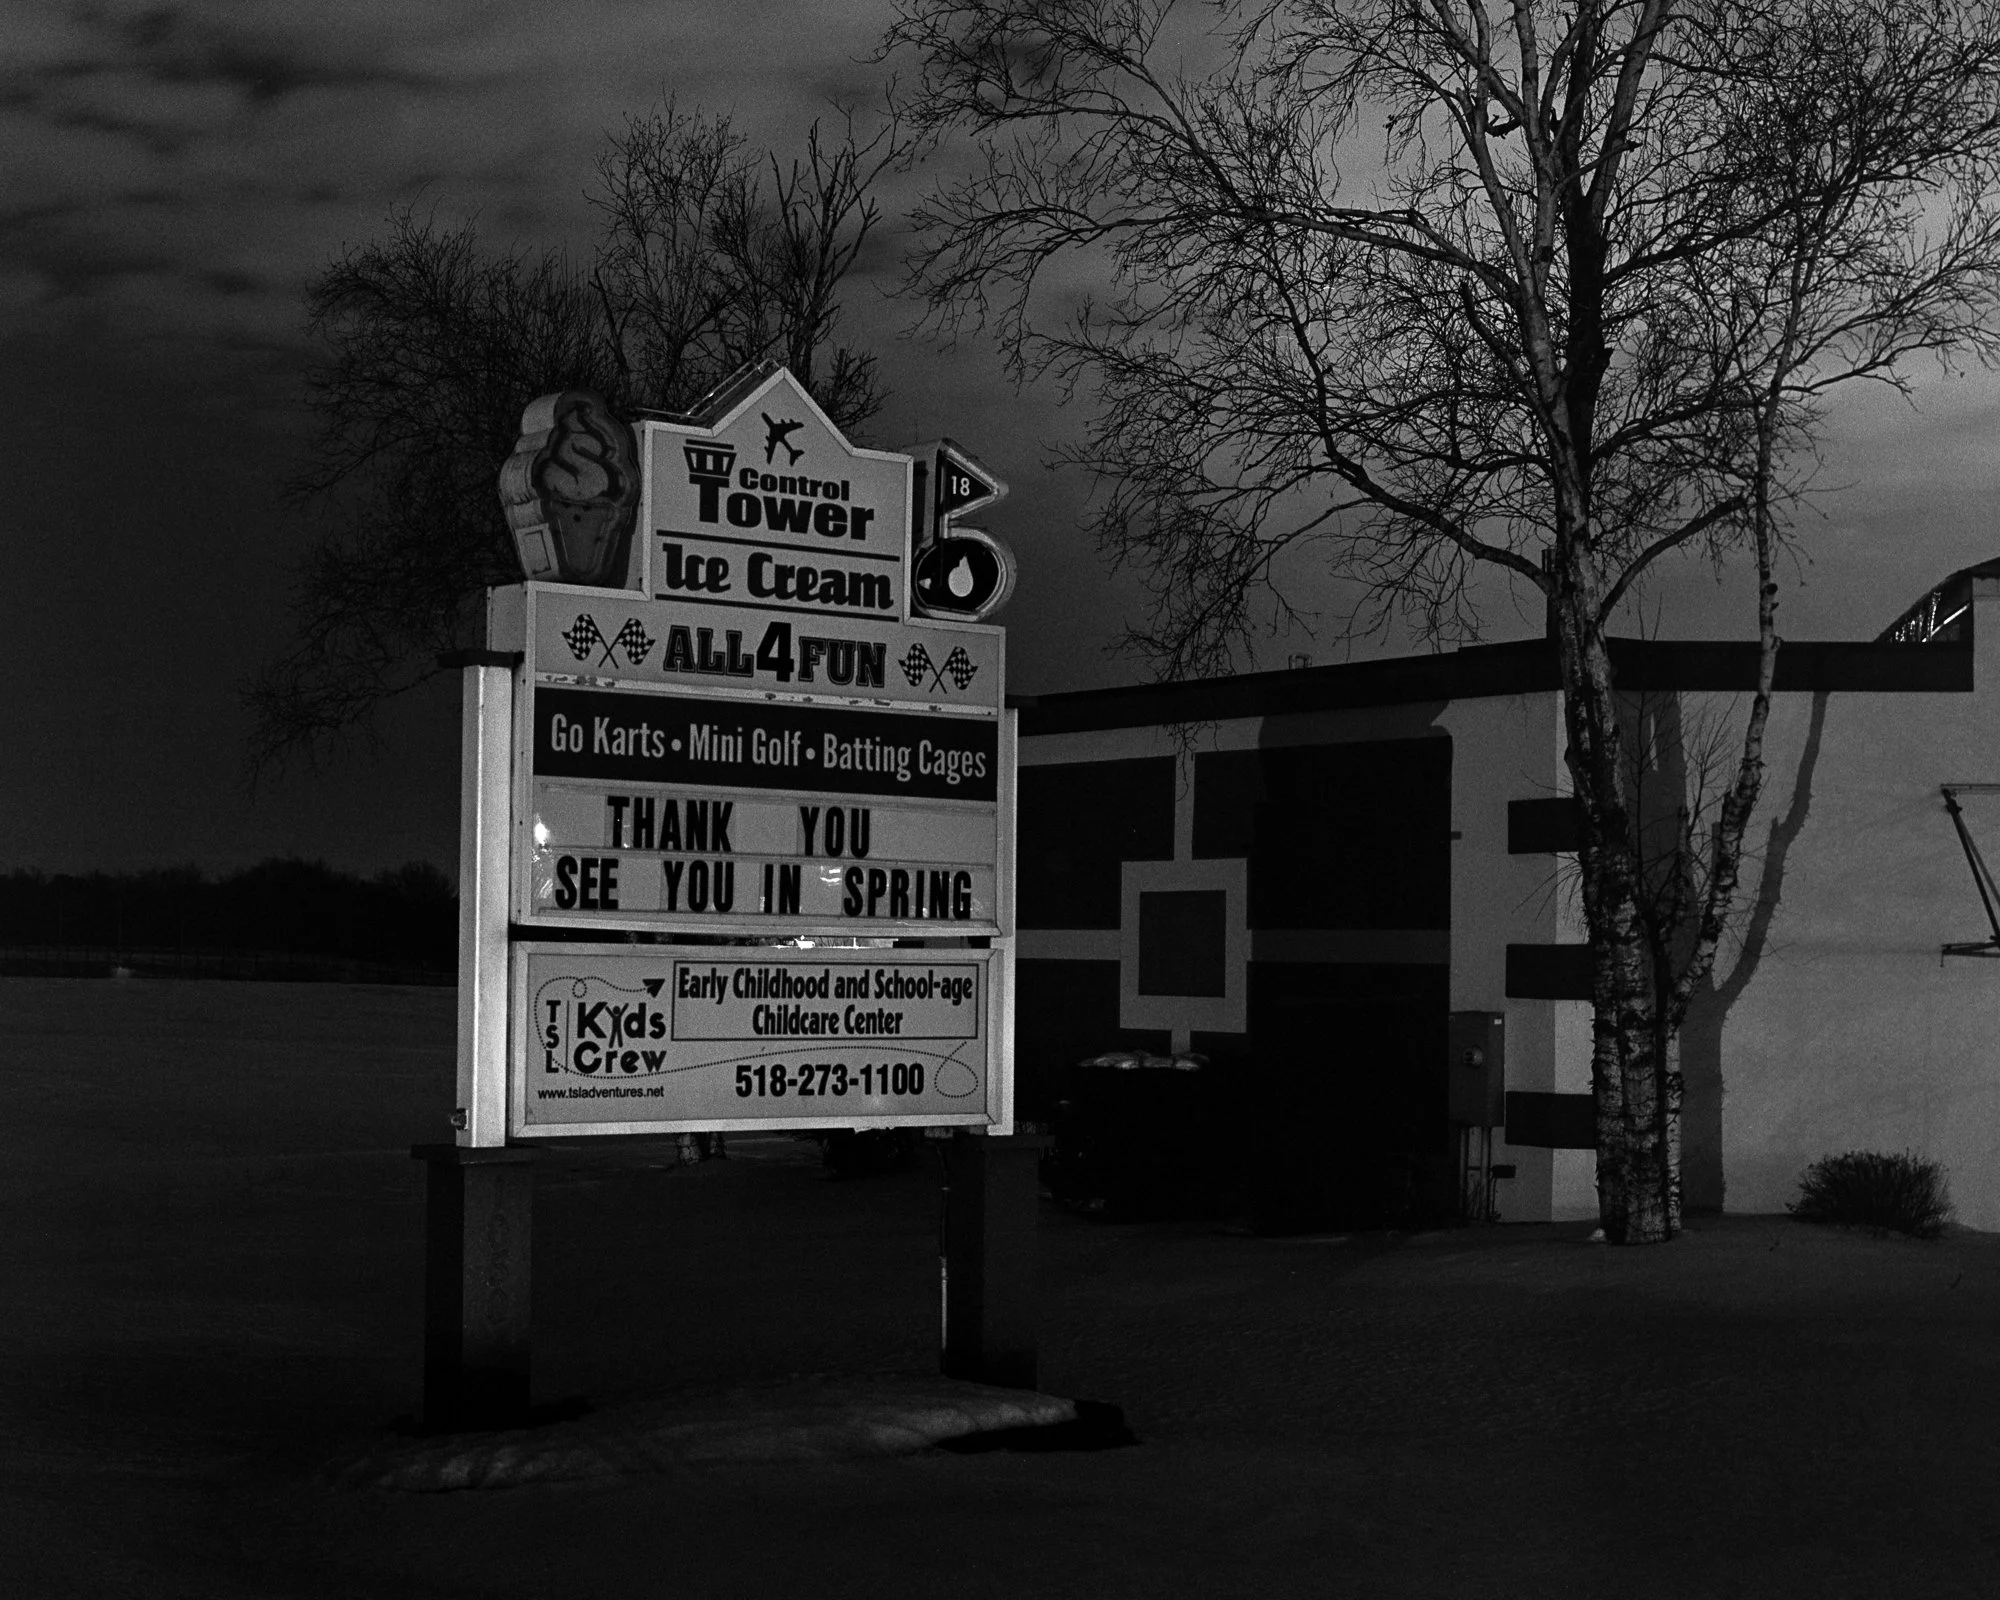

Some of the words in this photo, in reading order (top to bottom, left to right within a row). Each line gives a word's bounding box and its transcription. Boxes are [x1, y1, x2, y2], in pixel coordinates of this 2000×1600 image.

[739, 467, 850, 502] Control
[951, 474, 971, 497] 18
[689, 473, 875, 541] Tower
[662, 543, 731, 593] Ice
[746, 551, 894, 610] Cream
[551, 713, 583, 752] Go
[593, 716, 665, 757] Karts
[689, 723, 743, 763] Mini
[752, 727, 801, 766] Golf
[823, 733, 911, 782] Batting
[919, 740, 986, 784] Cages
[607, 796, 734, 853] THANK
[800, 806, 870, 858] YOU
[556, 855, 619, 910] SEE
[663, 860, 735, 913] YOU
[763, 864, 801, 915] IN
[843, 866, 972, 919] SPRING
[678, 967, 728, 1000] Early
[732, 967, 830, 1000] Childhood
[834, 968, 870, 999] and
[874, 969, 973, 1006] School-age
[752, 1004, 840, 1035] Childcare
[843, 1005, 904, 1035] Center
[574, 1041, 667, 1074] Crew
[538, 1086, 665, 1099] www.tsladventures.net
[735, 1062, 925, 1098] 518-273-1100
